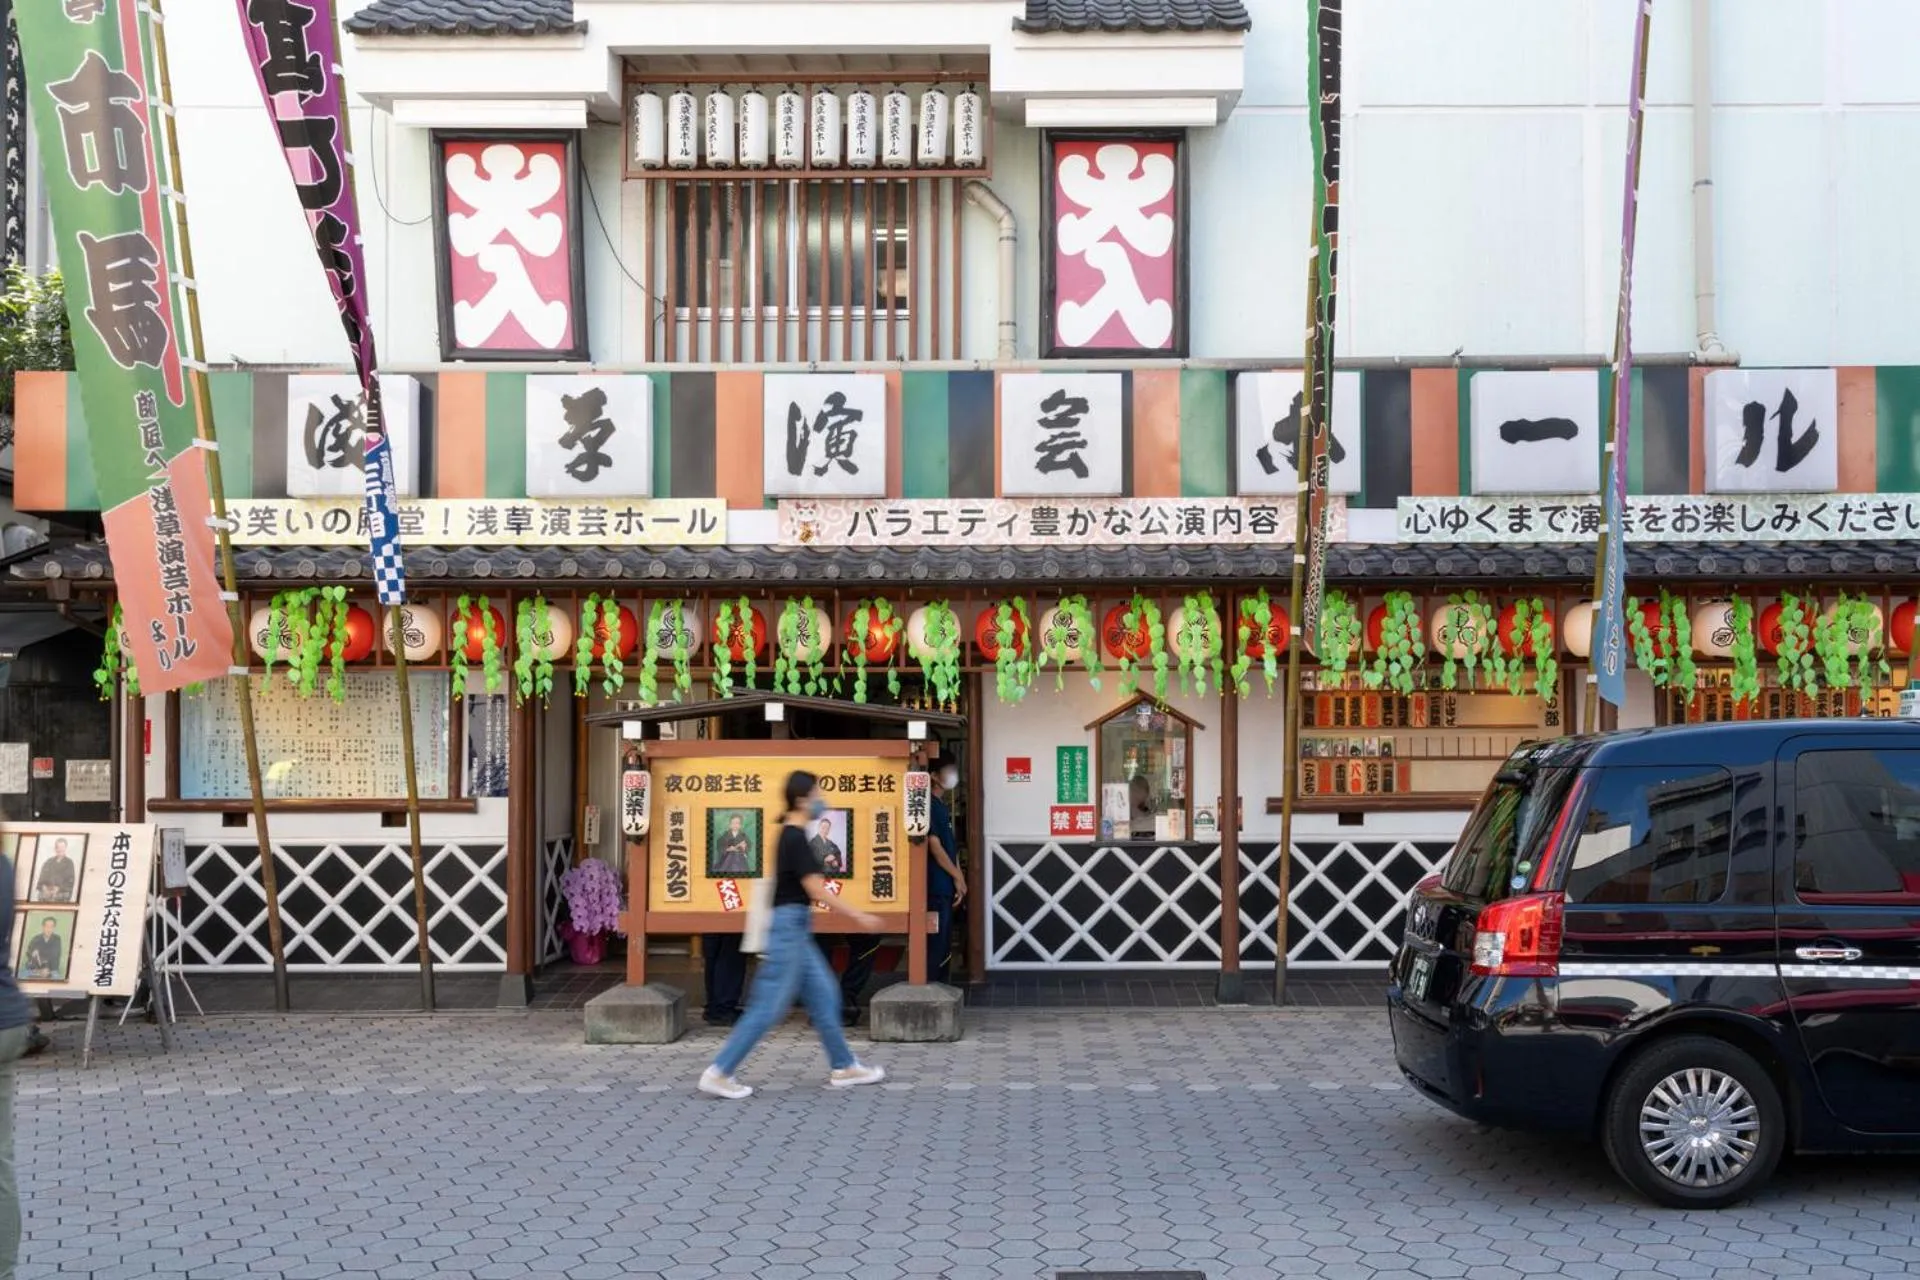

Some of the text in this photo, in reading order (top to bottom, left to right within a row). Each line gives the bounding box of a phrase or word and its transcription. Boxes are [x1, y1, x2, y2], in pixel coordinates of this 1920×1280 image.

[47, 0, 170, 369] 市馬
[846, 503, 1280, 537] バラエティ豊かな公演内容
[151, 620, 173, 671] より
[664, 774, 762, 793] 夜の部主任
[819, 774, 896, 793] の部主任
[1052, 811, 1094, 830] 禁煙
[94, 832, 131, 987] 本日の主な出演者
